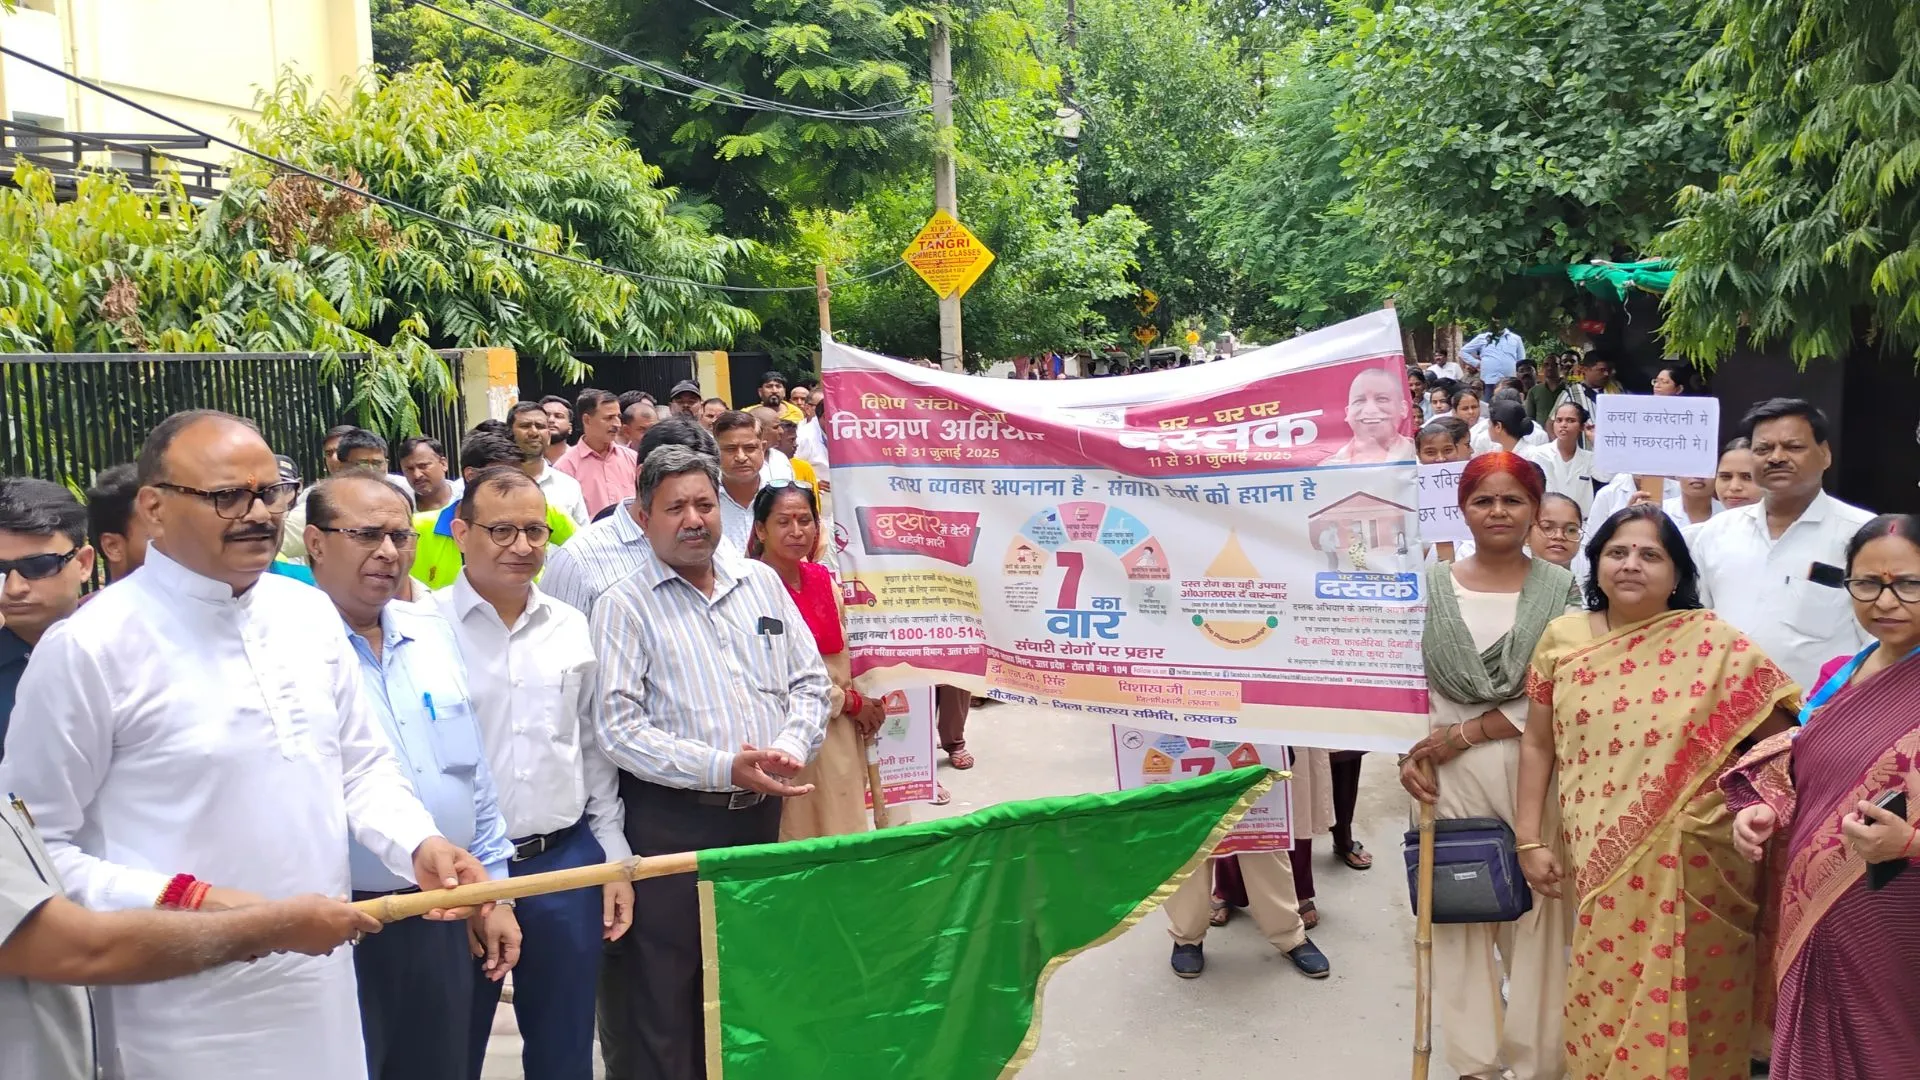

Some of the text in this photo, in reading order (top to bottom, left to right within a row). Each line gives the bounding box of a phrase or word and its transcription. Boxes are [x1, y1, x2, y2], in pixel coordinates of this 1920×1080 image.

[918, 239, 970, 250] TANGRI
[908, 249, 982, 259] COMMERCE CLASSES
[861, 393, 908, 410] विशेष
[1158, 401, 1280, 431] घर घर पर
[1607, 411, 1637, 424] कचरा
[1642, 408, 1694, 425] कचरेदानी
[830, 410, 931, 440] नियंत्रण
[1604, 432, 1626, 448] सोये
[1632, 435, 1687, 450] मच्छरदानी
[896, 444, 907, 457] से
[912, 448, 926, 458] 31
[929, 443, 962, 461] जुलाई
[966, 448, 1000, 459] 2025
[1148, 450, 1292, 469] 11 से 31 जुलाई 2025
[1418, 468, 1463, 490] र रविव
[992, 479, 1066, 496] अपनाना
[1072, 474, 1086, 496] है
[1203, 482, 1230, 505] को
[1237, 484, 1294, 504] हराना
[1300, 476, 1317, 501] है
[1442, 505, 1460, 520] पर
[950, 524, 972, 537] देरी
[926, 536, 946, 548] भारी
[1056, 552, 1084, 610] 7
[1181, 580, 1200, 588] दस्त
[1203, 579, 1220, 588] रोग
[1258, 582, 1288, 590] उपचार
[1318, 580, 1414, 598] दस्तक
[1091, 597, 1122, 610] का
[1316, 602, 1344, 612] अभियान
[888, 616, 910, 625] अधिक
[911, 614, 939, 624] जानकारी
[1045, 610, 1128, 639] वार
[890, 626, 987, 640] 1800-180-5145
[1015, 638, 1166, 659] संचारी रोगों पर प्रहार
[1113, 666, 1128, 674] 104
[1134, 666, 1150, 674] Follow
[1042, 674, 1066, 686] सिंह
[1118, 680, 1162, 694] विशाख
[1166, 683, 1183, 695] जी
[986, 688, 1238, 725] सौजन्य से जिला स्वास्थ्य समिति, लखनऊ
